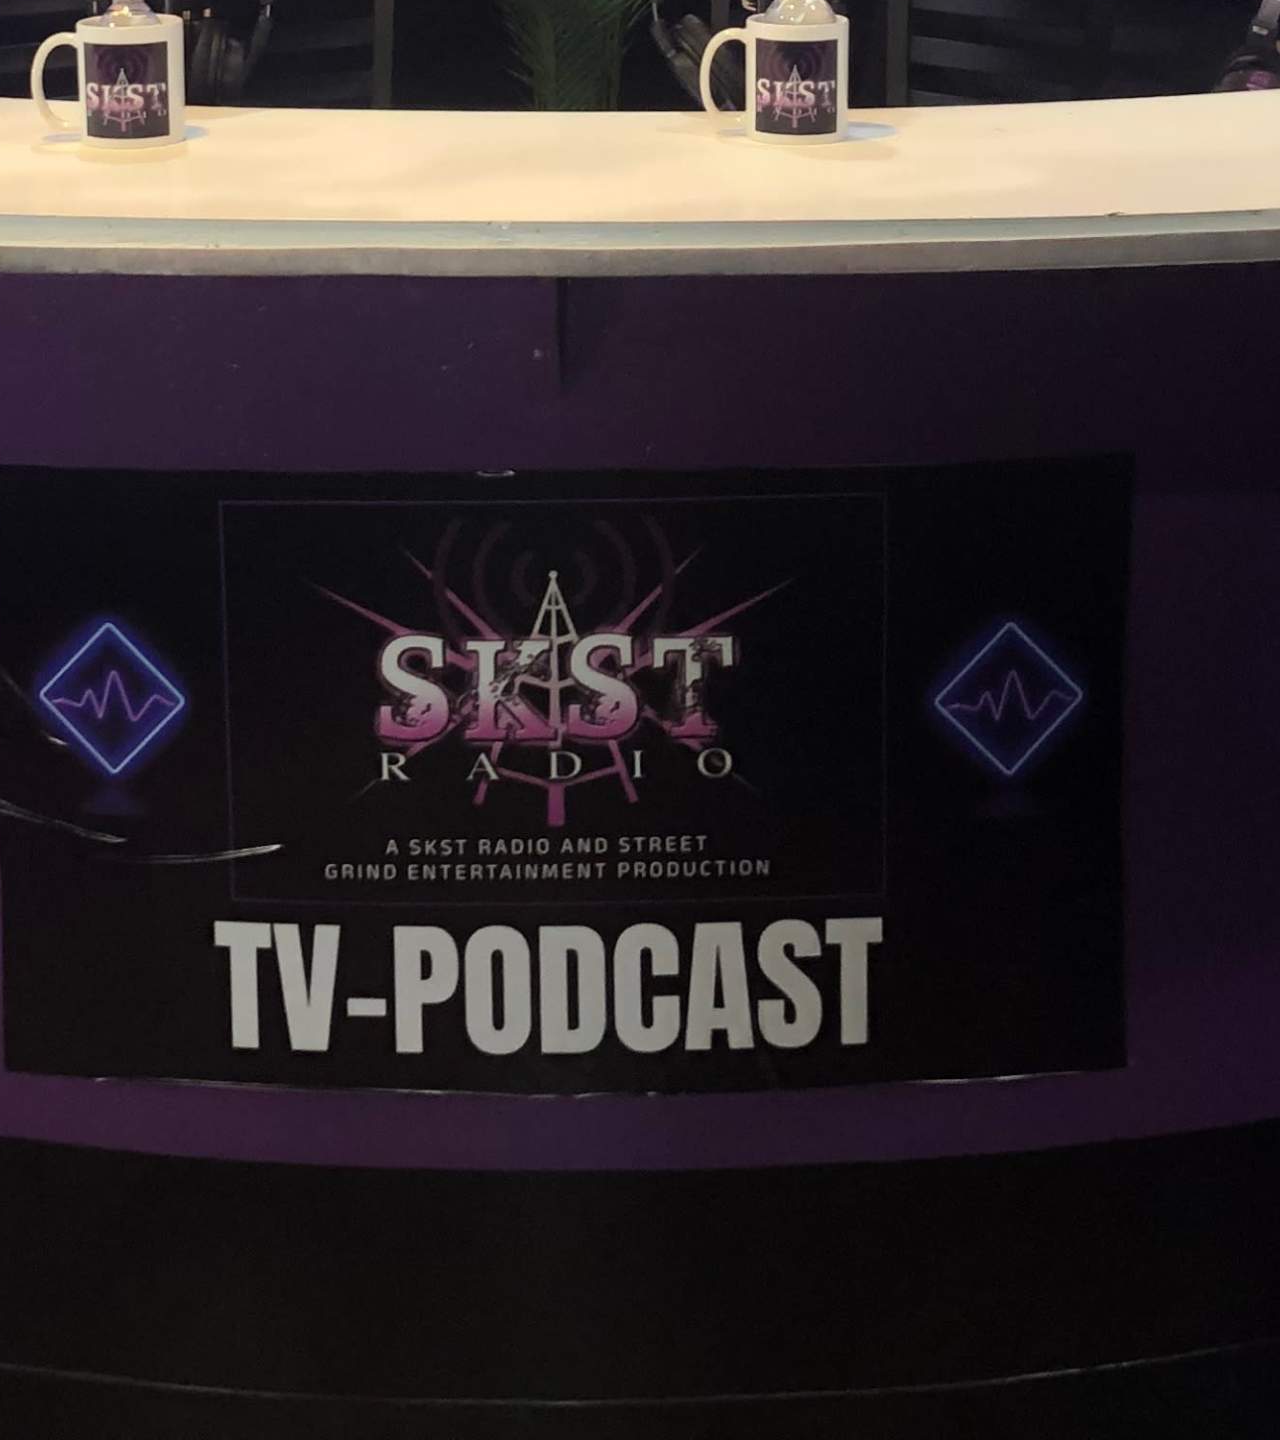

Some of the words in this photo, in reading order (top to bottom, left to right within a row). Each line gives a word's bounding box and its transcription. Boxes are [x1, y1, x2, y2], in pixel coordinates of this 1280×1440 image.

[377, 632, 736, 741] SKST
[380, 747, 734, 781] RADIO
[384, 839, 400, 855] A
[409, 839, 468, 856] SKST
[478, 837, 551, 855] RADIO
[560, 837, 609, 854] AND
[619, 835, 709, 853] STREET
[324, 863, 398, 881] GRIND
[407, 861, 608, 881] ENTERTAINMENT
[616, 859, 771, 879] PRODUCTION
[214, 917, 883, 1055] TV-PODCAST
